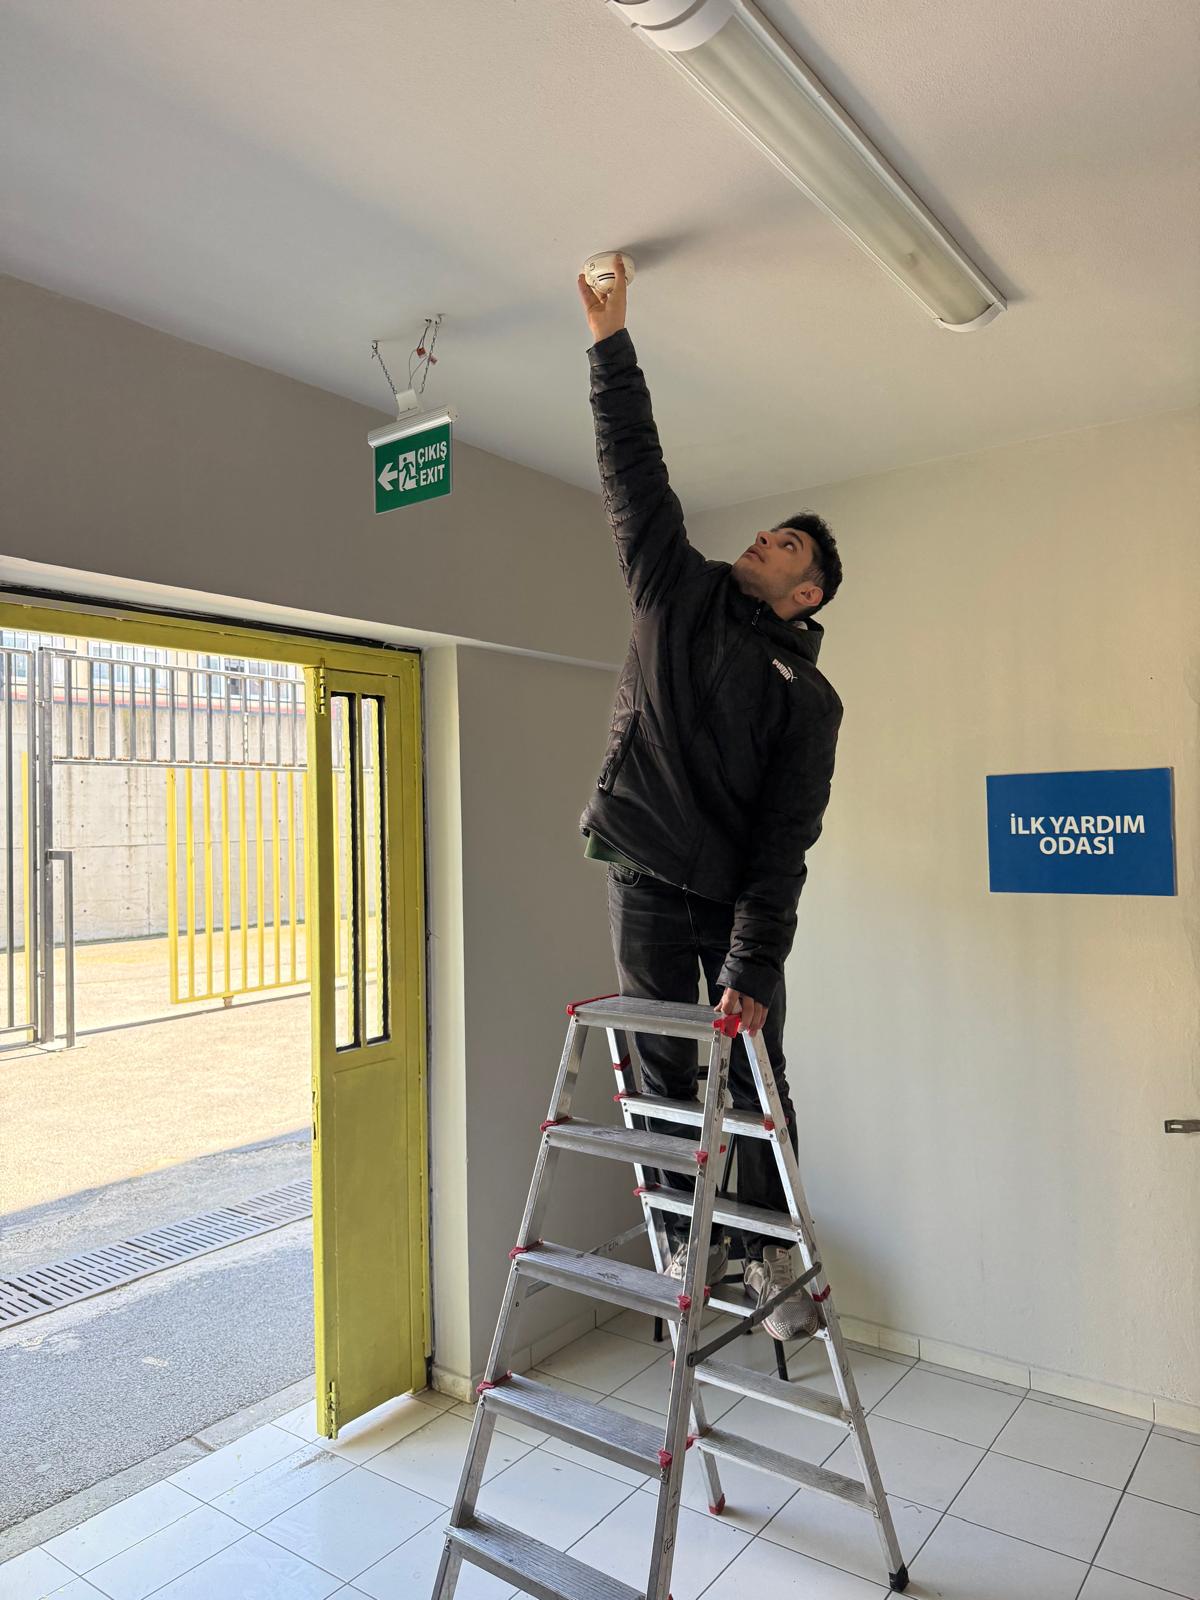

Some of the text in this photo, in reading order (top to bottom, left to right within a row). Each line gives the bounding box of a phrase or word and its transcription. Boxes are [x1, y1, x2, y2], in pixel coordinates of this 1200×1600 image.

[417, 440, 448, 467] ÇIKIŞ
[420, 464, 446, 486] EXIT
[771, 658, 792, 681] PUMA
[1010, 813, 1146, 835] İLK YARDIM
[1039, 836, 1115, 855] ODASI
